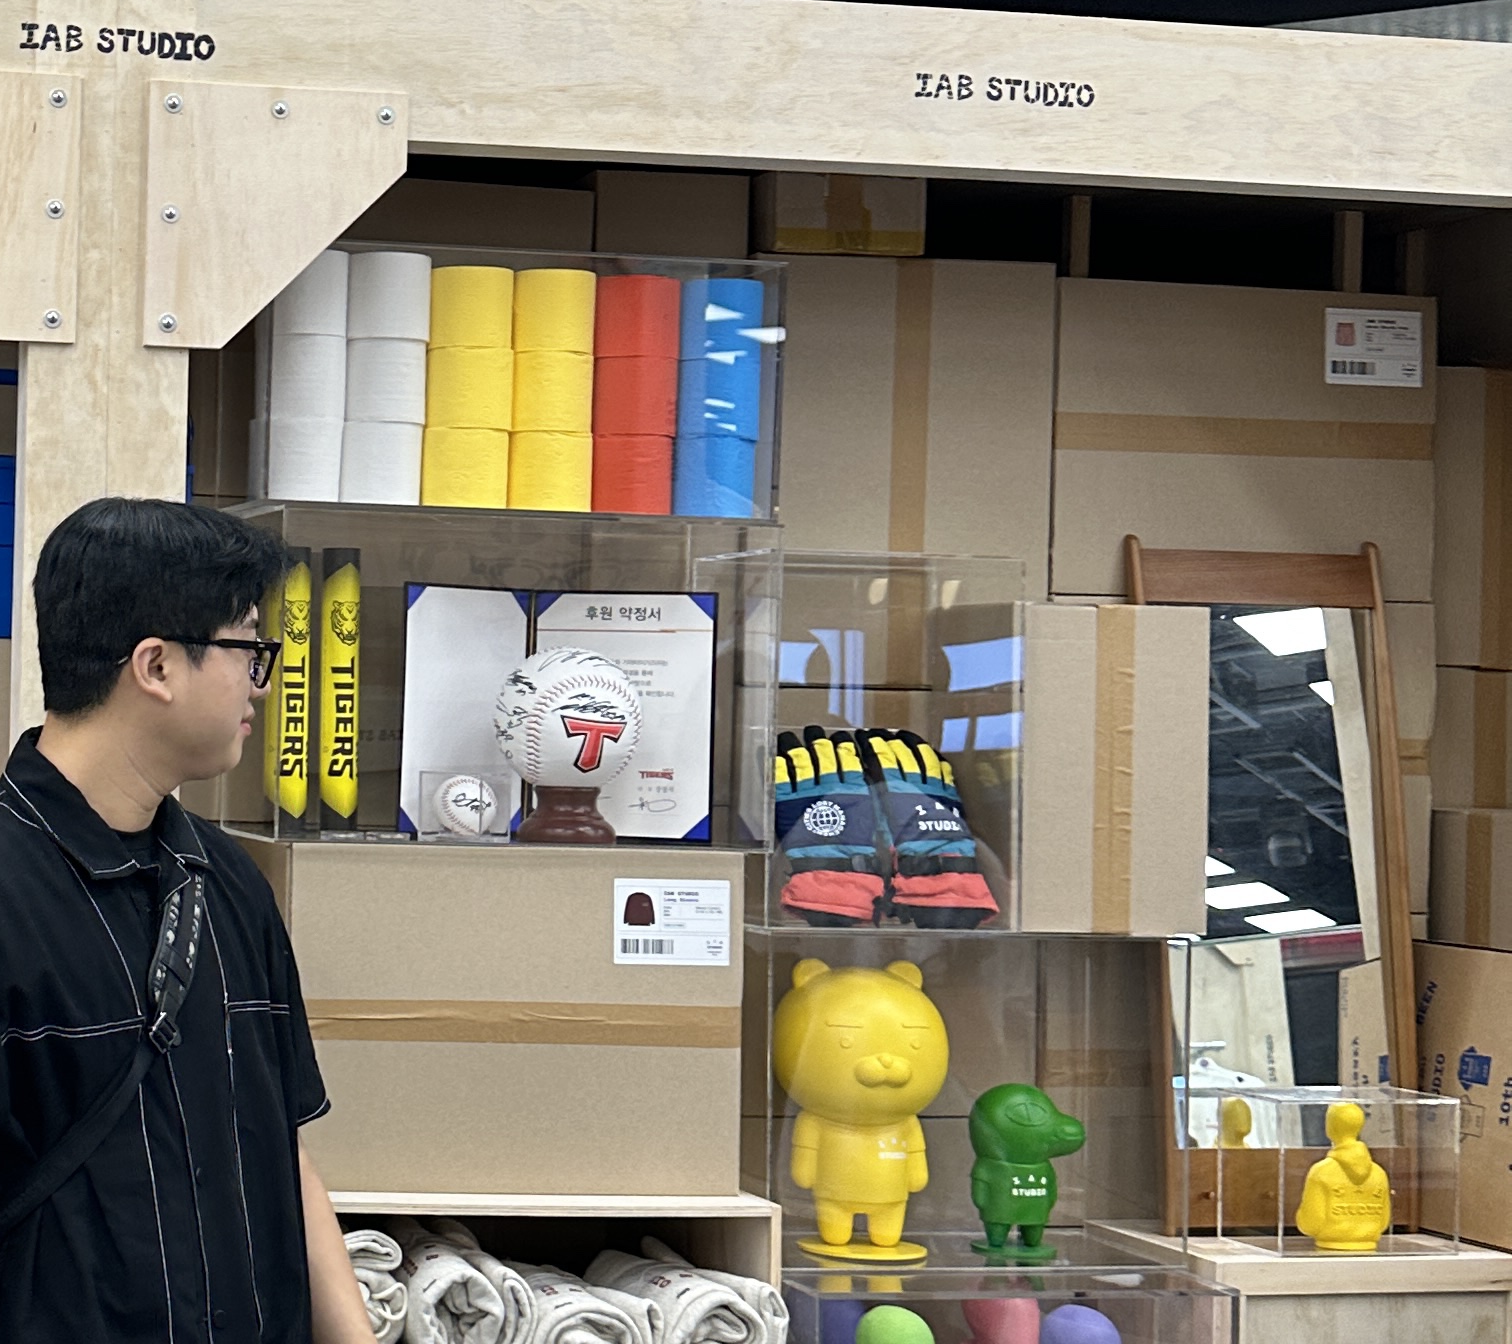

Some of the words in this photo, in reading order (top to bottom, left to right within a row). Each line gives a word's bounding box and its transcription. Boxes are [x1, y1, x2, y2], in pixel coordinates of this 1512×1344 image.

[19, 22, 84, 52] IAB
[96, 27, 217, 61] STUDIO
[914, 72, 974, 101] IAB
[986, 76, 1096, 108] STUDIO
[585, 606, 613, 621] 후원
[619, 607, 662, 622] 약정서
[279, 655, 306, 781] TIGERS
[328, 656, 356, 781] TIGERS
